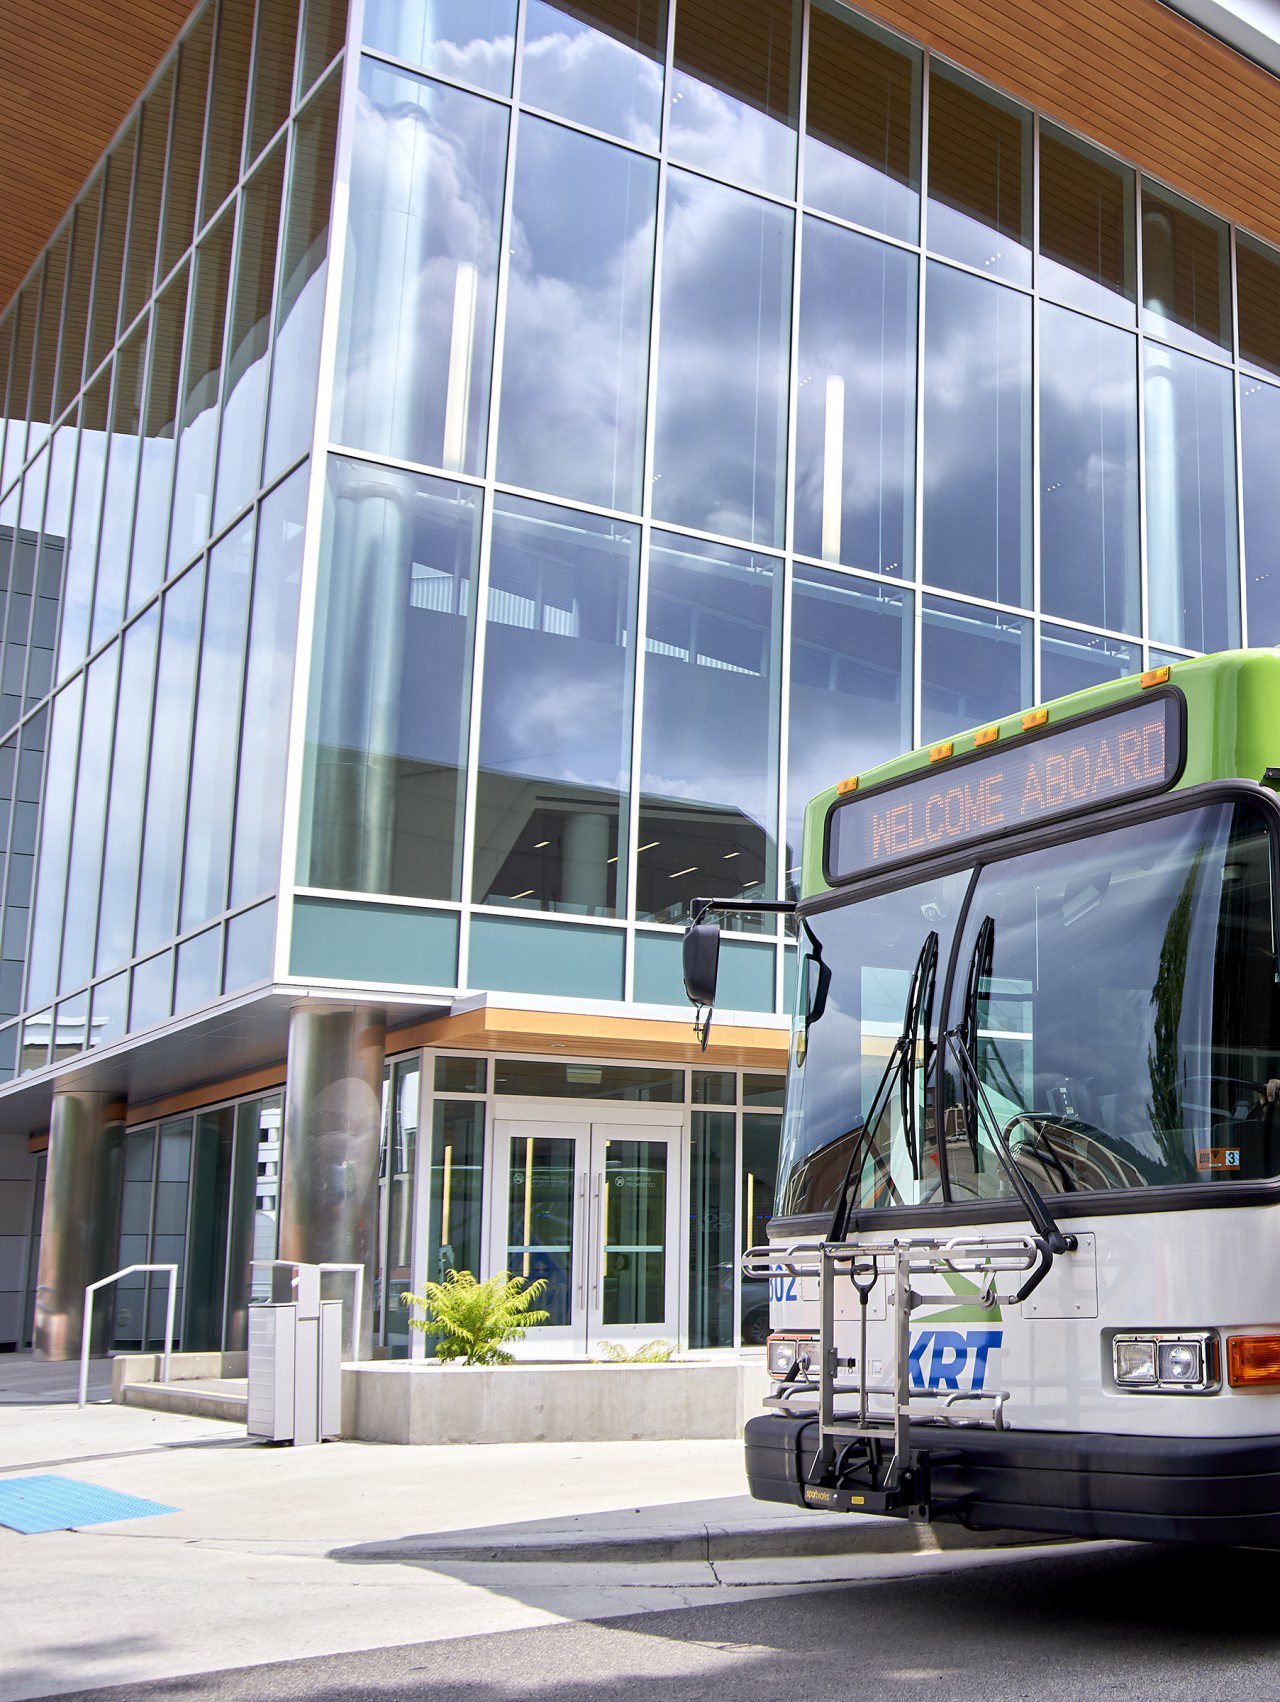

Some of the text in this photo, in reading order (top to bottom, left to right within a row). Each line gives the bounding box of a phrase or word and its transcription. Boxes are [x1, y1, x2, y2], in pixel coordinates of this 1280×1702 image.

[872, 721, 1166, 859] WELCOME ABOARD
[1228, 1151, 1236, 1165] 3
[909, 1331, 1004, 1399] KRT
